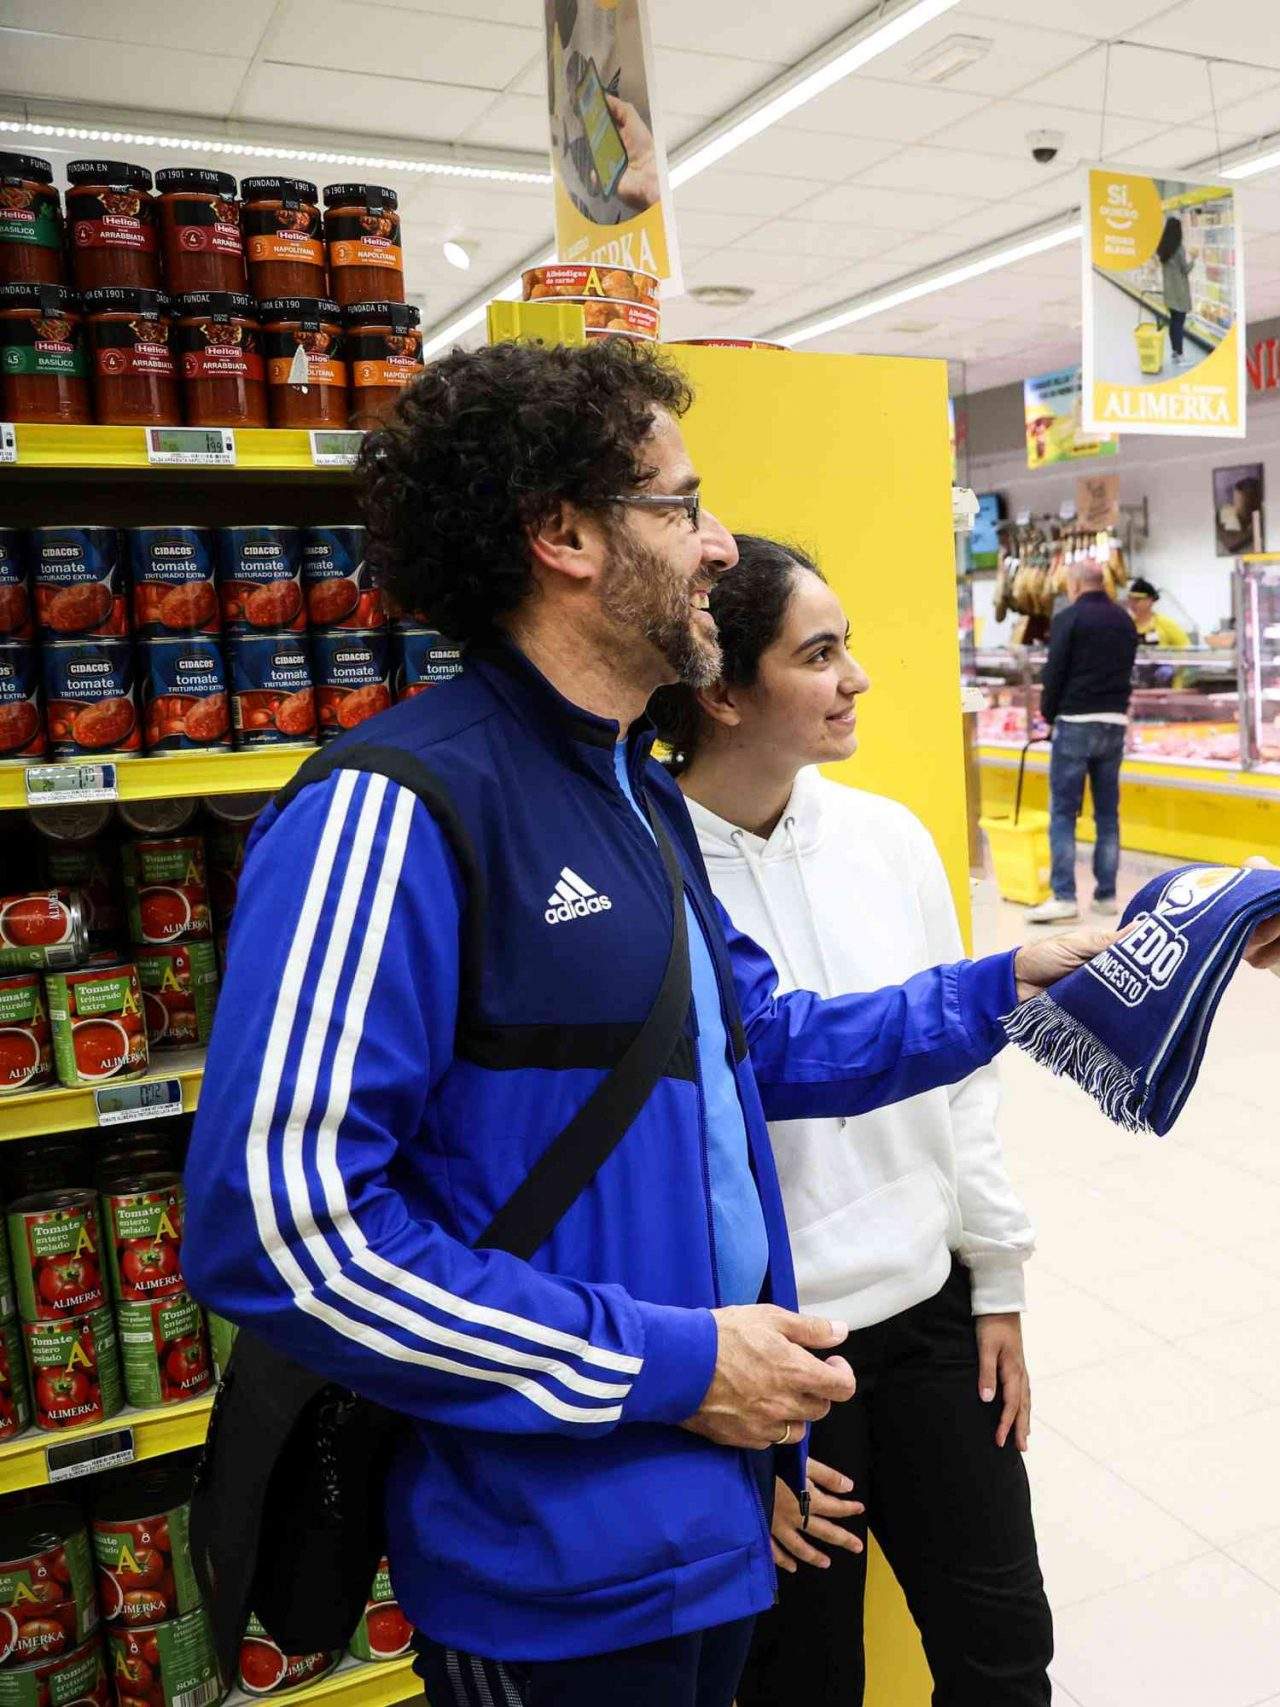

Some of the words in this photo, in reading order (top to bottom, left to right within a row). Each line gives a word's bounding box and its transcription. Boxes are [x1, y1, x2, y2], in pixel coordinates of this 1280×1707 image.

[582, 267, 606, 296] A
[286, 300, 300, 309] 190
[304, 355, 329, 363] elios
[1103, 392, 1230, 422] ALIMERKA
[42, 547, 80, 557] CIDACOS
[154, 546, 192, 556] CIDACOS
[243, 546, 280, 556] CIDACOS
[41, 561, 85, 574] tomate
[152, 560, 197, 572] tomate
[240, 560, 284, 571] tomate
[275, 656, 305, 665] CIDACOS
[336, 652, 370, 662] CIDACOS
[430, 650, 460, 659] CIDACOS
[71, 663, 110, 674] CIDACOS
[179, 660, 214, 670] CIDACOS
[427, 663, 464, 674] tomate
[271, 670, 308, 681] tomate
[333, 666, 374, 677] tomate
[67, 678, 114, 690] tomate
[176, 675, 218, 686] tomate
[544, 894, 613, 925] adidas
[1120, 917, 1182, 982] EDO
[78, 982, 121, 995] Tomate
[121, 986, 142, 1017] A
[118, 1207, 161, 1219] Tomate
[119, 1217, 149, 1227] entero
[154, 1212, 178, 1244] A
[34, 1221, 79, 1236] Tomate
[120, 1226, 150, 1236] pelado
[72, 1226, 96, 1260] A
[134, 1273, 184, 1291] ALIMERKA
[53, 1288, 101, 1310] ALIMERKA
[31, 1335, 73, 1346] Tomate
[65, 1340, 93, 1373] A
[47, 1401, 99, 1420] ALIMERKA
[116, 1545, 141, 1575] A
[11, 1582, 40, 1607] A
[4, 1630, 64, 1653] ALIMERKA
